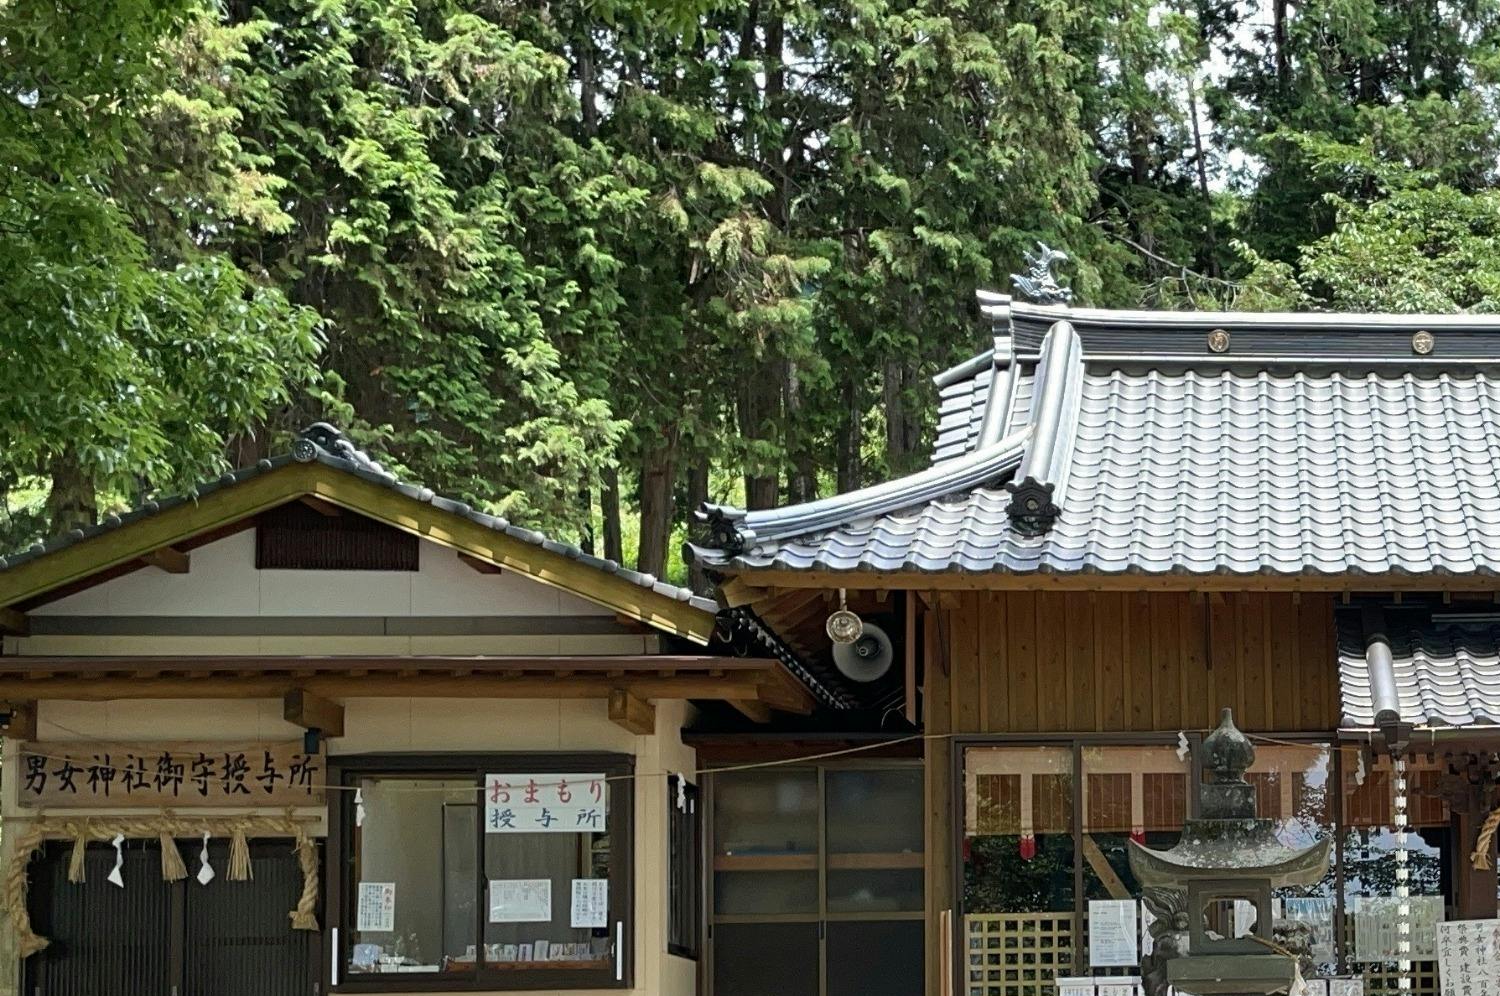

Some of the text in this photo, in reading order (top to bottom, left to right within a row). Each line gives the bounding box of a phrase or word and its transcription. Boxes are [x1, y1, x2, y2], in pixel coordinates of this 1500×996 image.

[24, 751, 319, 797] 男女神社御守授与所
[490, 779, 602, 804] おまもり
[491, 808, 602, 828] 授与所
